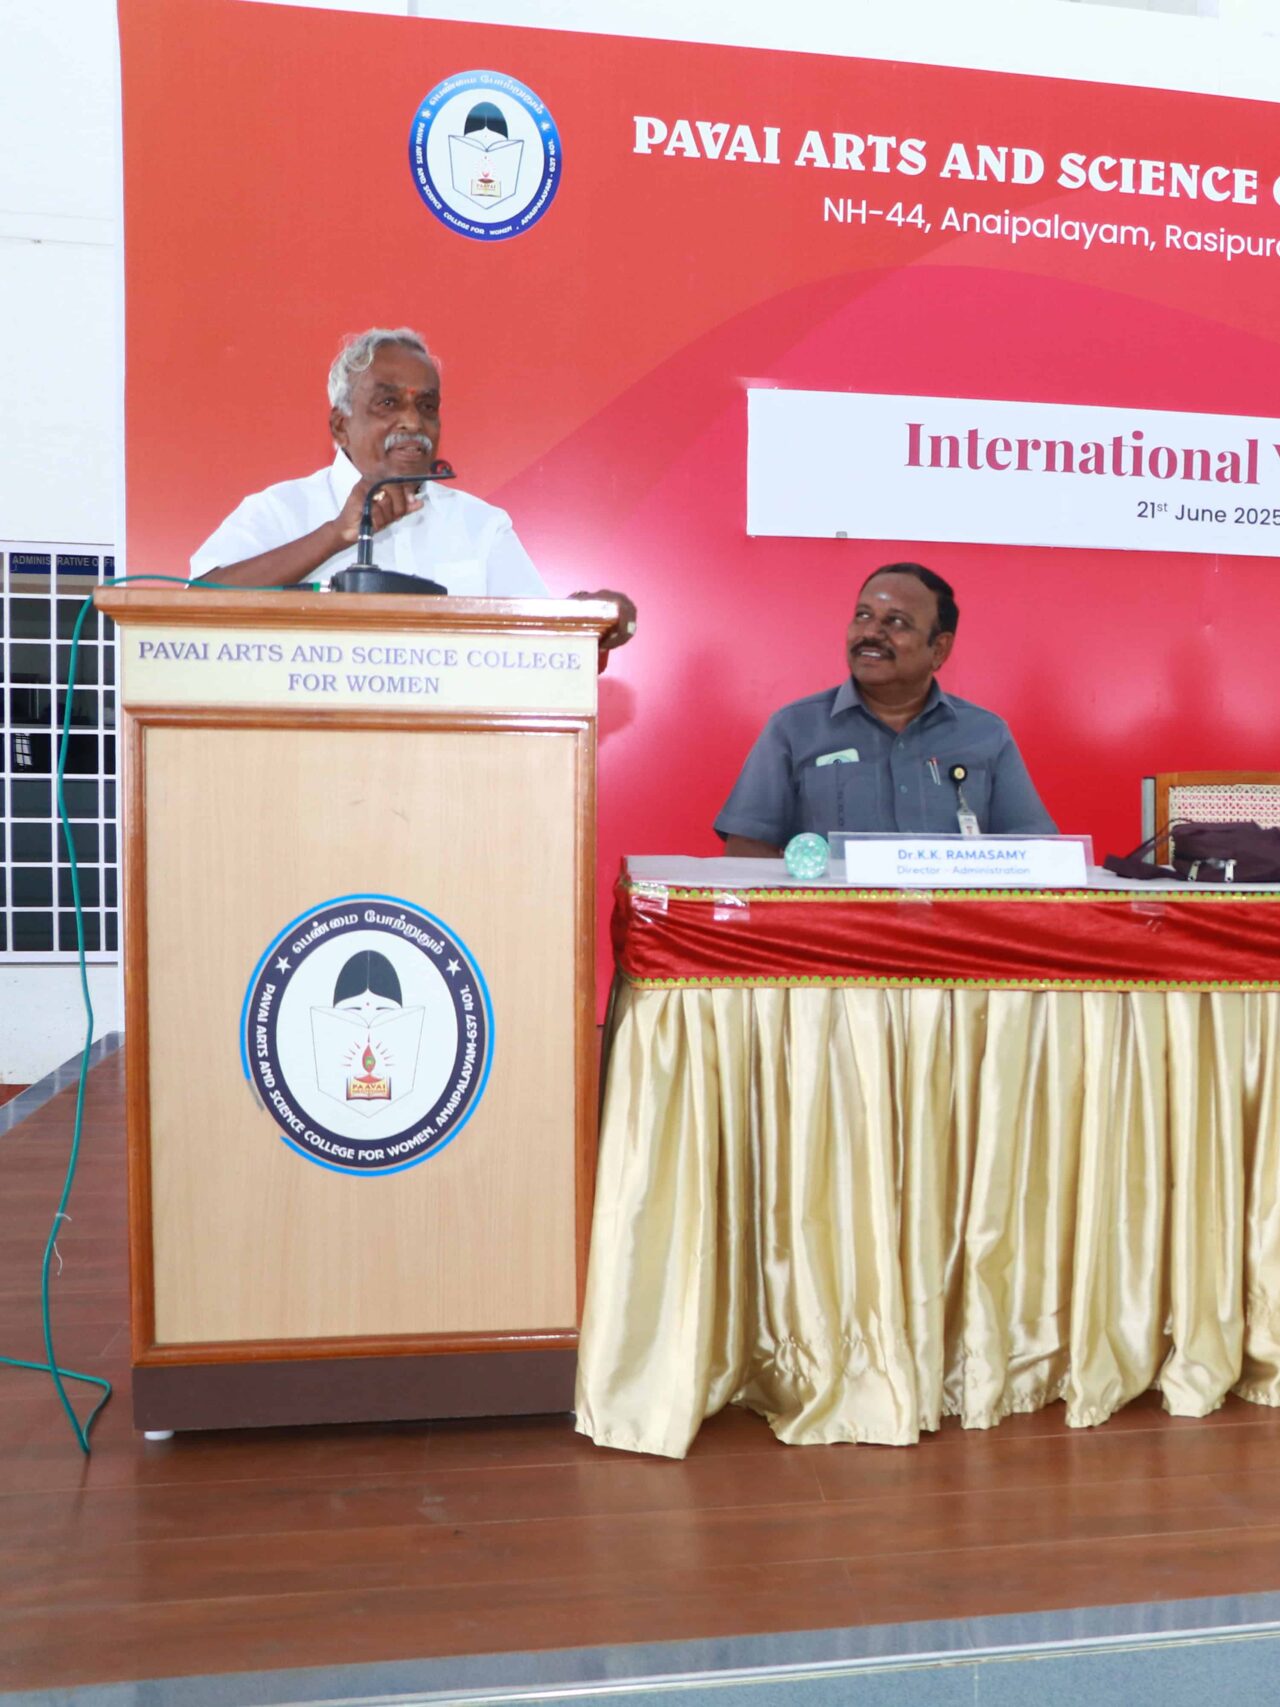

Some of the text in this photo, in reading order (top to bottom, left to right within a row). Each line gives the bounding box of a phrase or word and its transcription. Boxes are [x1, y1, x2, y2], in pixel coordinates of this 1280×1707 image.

[633, 115, 781, 165] PAVAI
[795, 127, 927, 176] ARTS
[940, 142, 1045, 186] AND
[1057, 153, 1258, 206] SCIENCE
[823, 197, 932, 233] NH-44,
[940, 206, 1157, 252] Anaipalayam,
[904, 422, 1260, 485] International
[1175, 504, 1227, 523] June
[12, 555, 91, 567] ADMINISRATIVE
[138, 641, 582, 671] PAVAI ARTS AND SCIENCE COLLEGE
[288, 673, 440, 694] FOR WOMEN
[897, 865, 1031, 875] Director Administration
[946, 849, 1027, 861] RAMASAMY
[257, 983, 276, 1022] PAVAI
[256, 1024, 269, 1058] ARTS
[259, 1060, 276, 1089] AND
[269, 1089, 306, 1134] SCIENCE
[304, 1130, 355, 1161] COLLEGE
[358, 1149, 385, 1162] FOR
